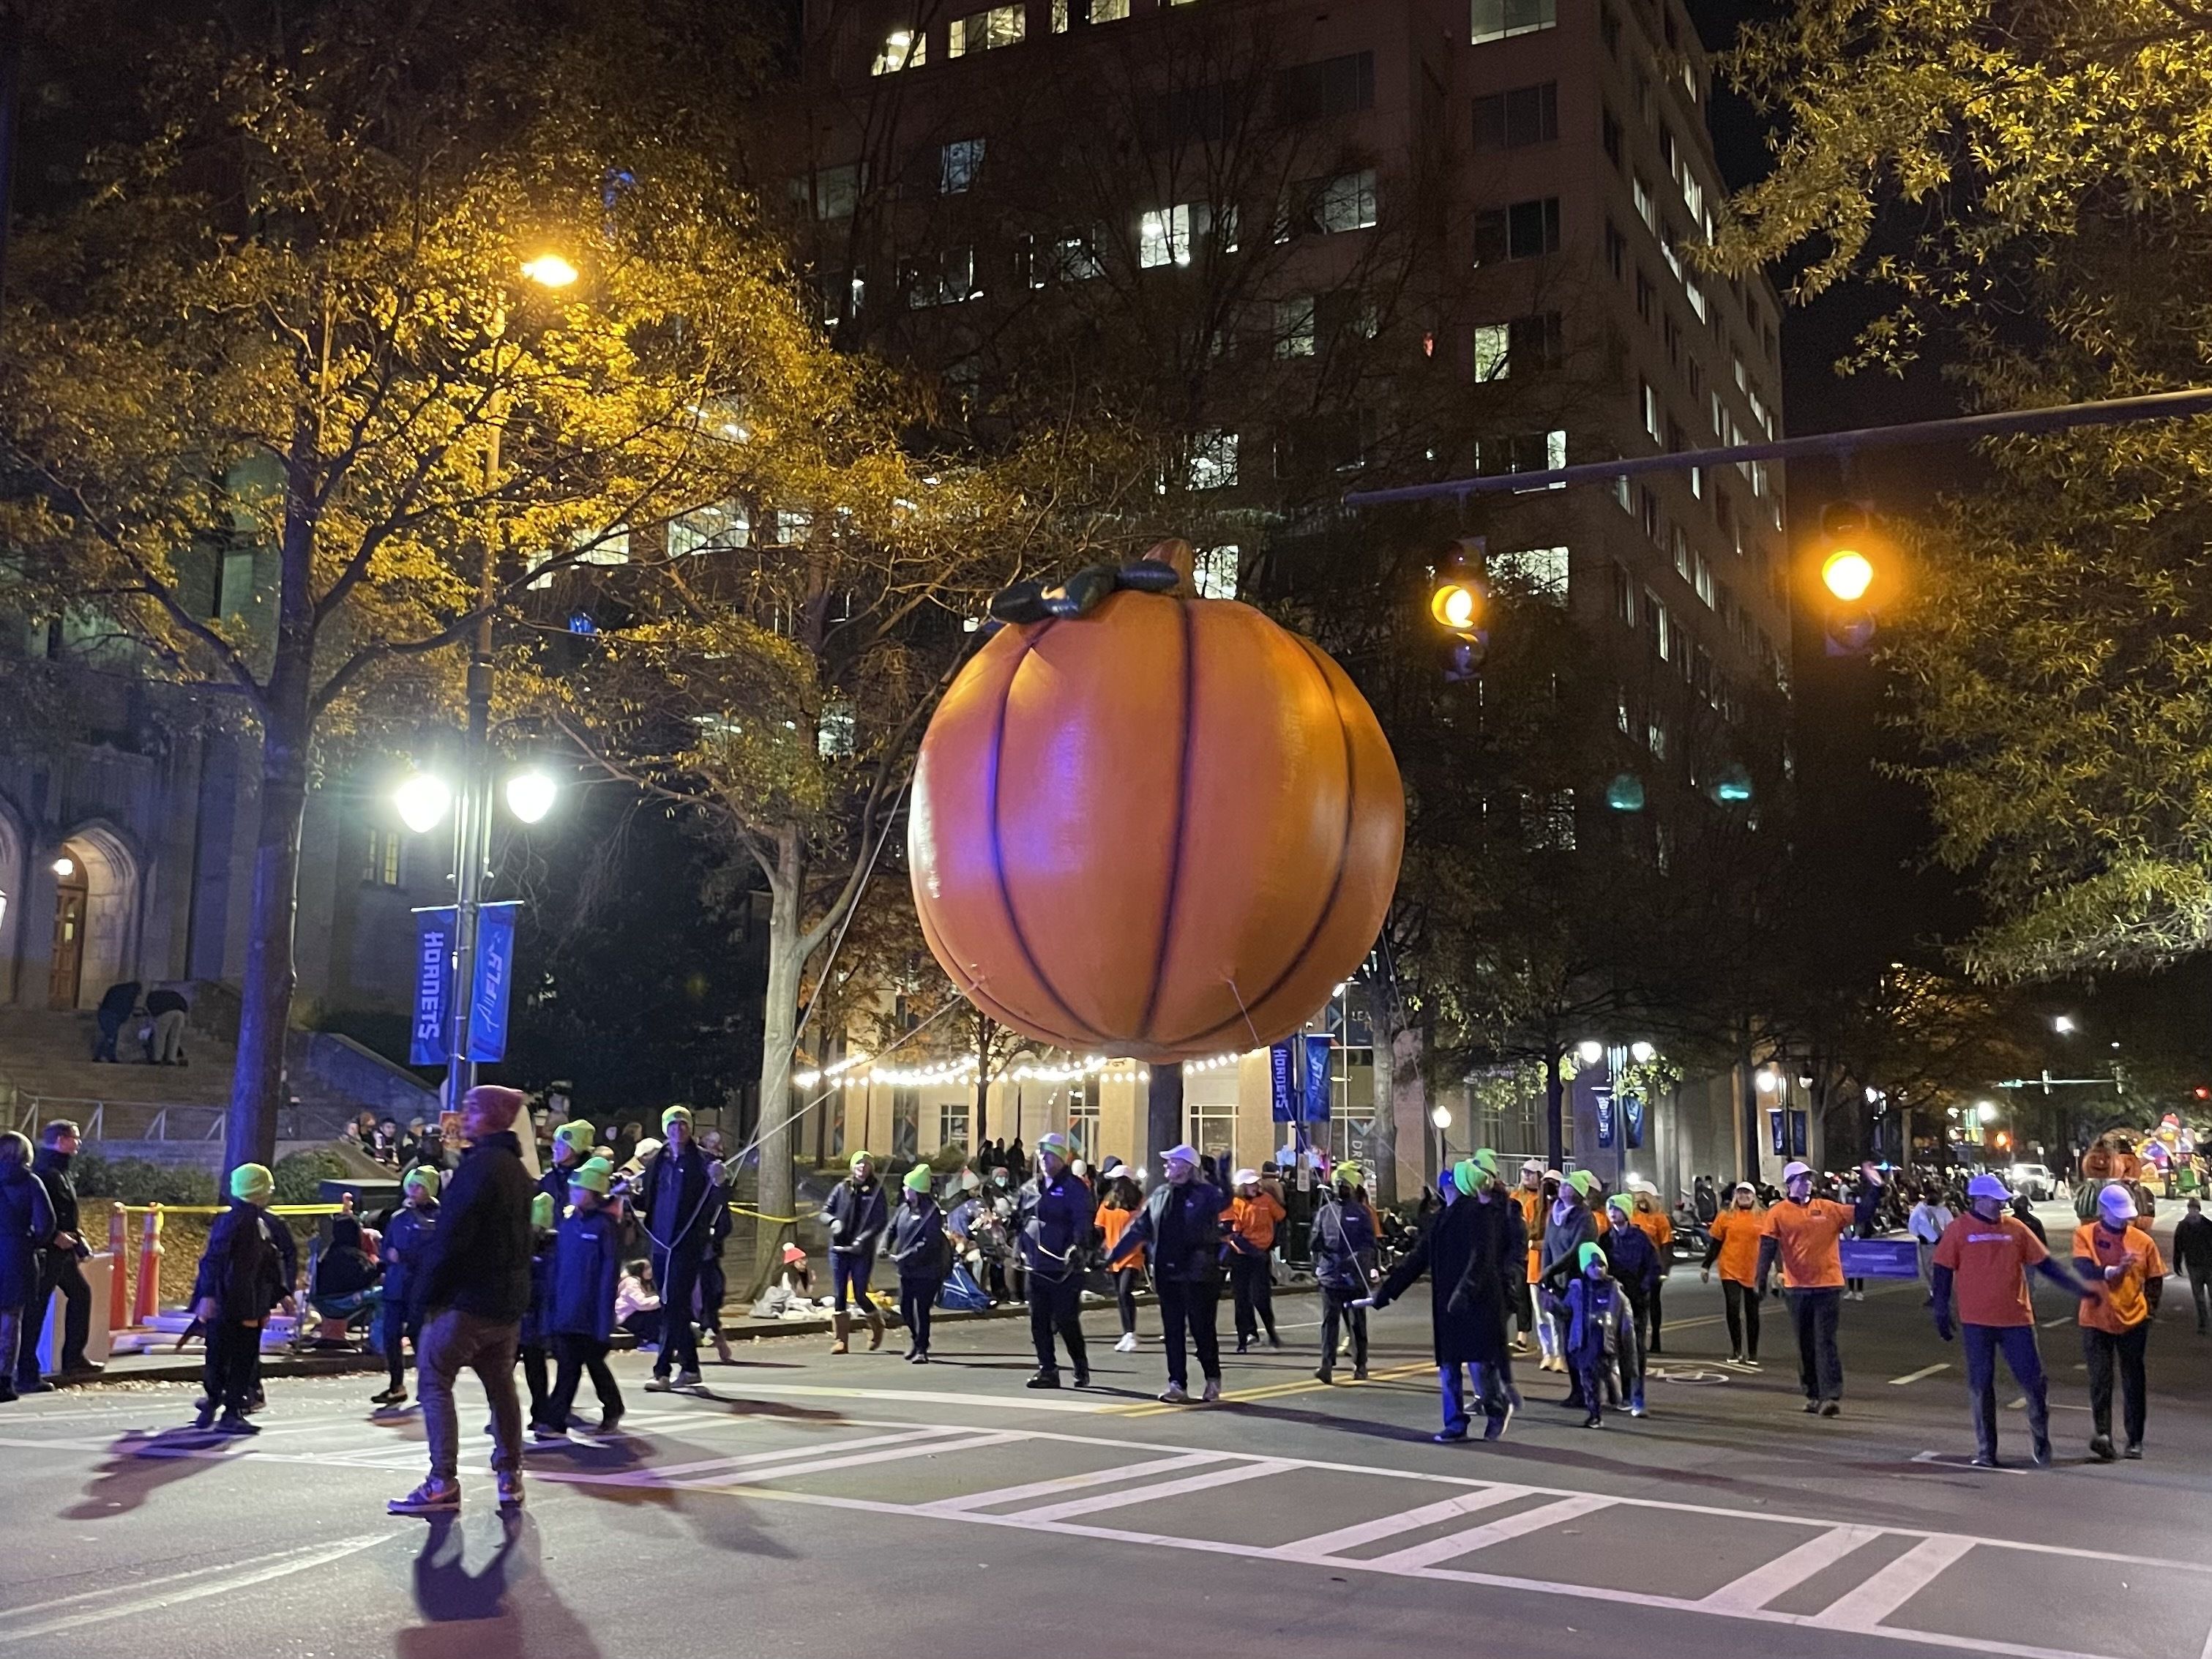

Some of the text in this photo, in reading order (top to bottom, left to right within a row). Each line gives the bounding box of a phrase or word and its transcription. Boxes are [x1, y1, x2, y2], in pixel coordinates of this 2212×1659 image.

[418, 931, 444, 1040] HORNETS
[1352, 1011, 1372, 1022] LEA
[1274, 1049, 1288, 1109] HORNETS
